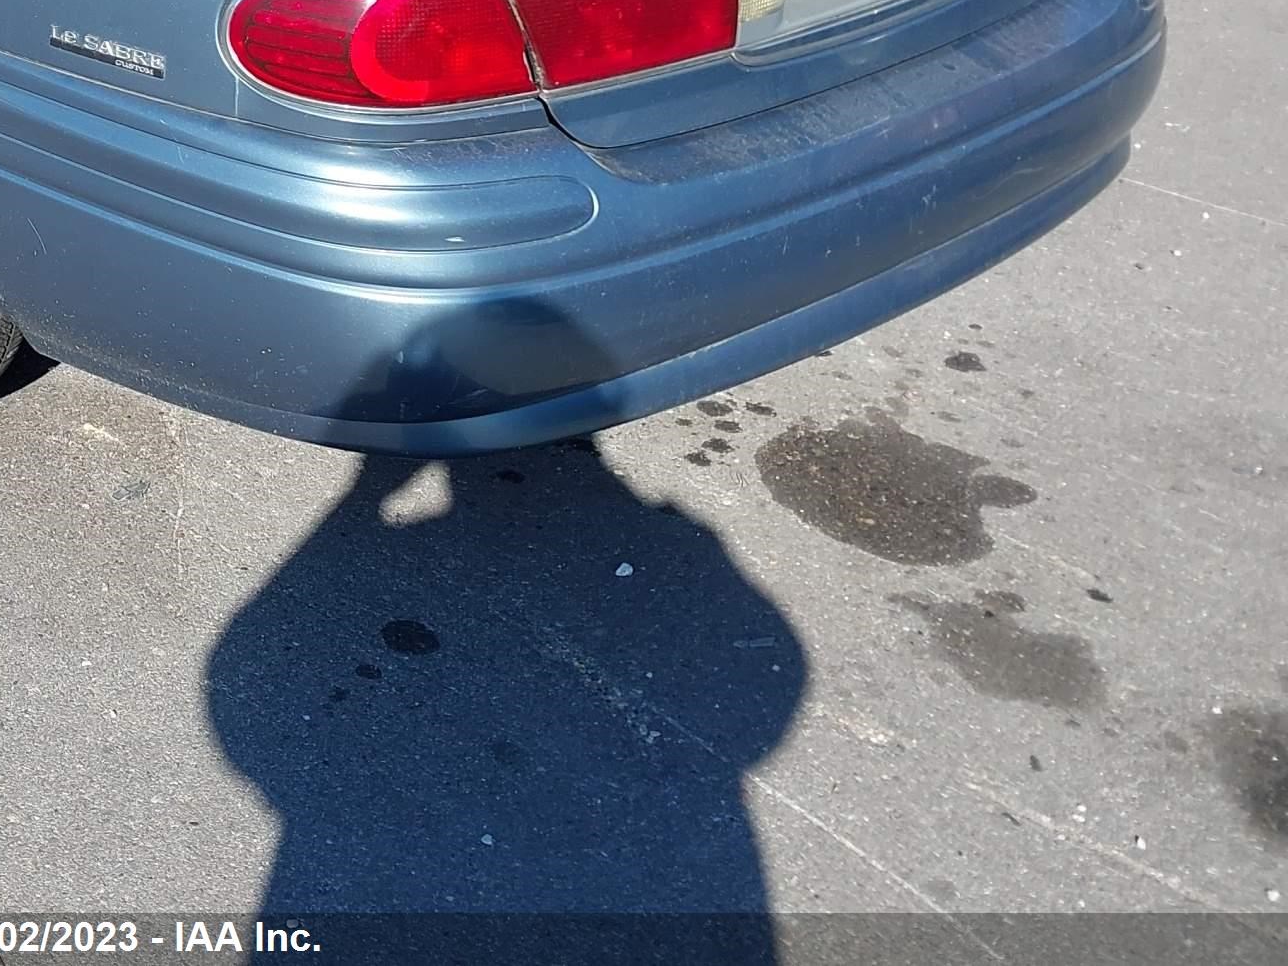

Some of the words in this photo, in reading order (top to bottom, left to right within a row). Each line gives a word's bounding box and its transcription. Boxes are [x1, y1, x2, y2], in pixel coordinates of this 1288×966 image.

[50, 23, 77, 44] Le
[84, 34, 165, 68] SABRE
[114, 59, 155, 76] CUSTOM
